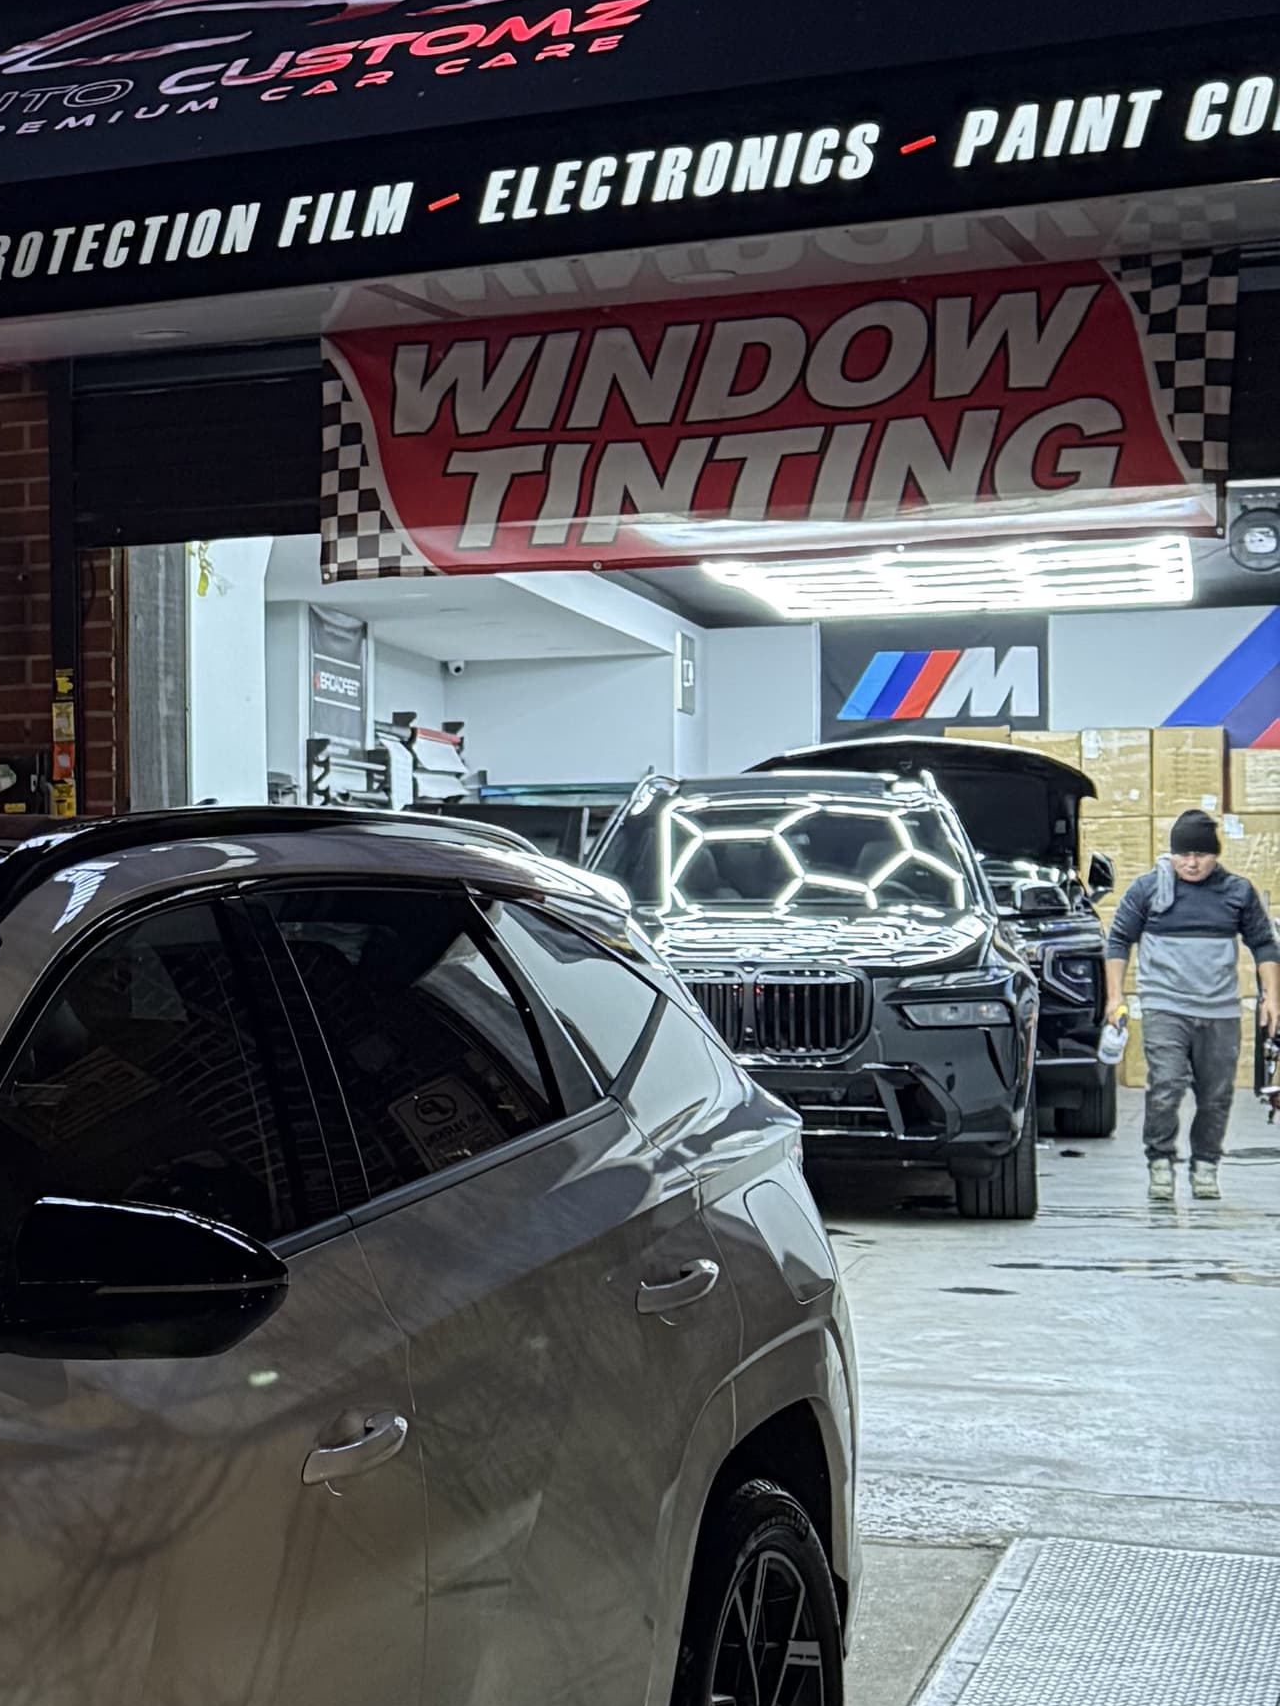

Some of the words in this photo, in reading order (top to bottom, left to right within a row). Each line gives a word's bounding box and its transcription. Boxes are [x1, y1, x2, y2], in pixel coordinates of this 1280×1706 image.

[260, 70, 395, 102] CAR
[435, 34, 624, 75] CARE
[277, 181, 415, 249] FILM
[477, 123, 881, 225] ELECTRONICS
[953, 89, 1163, 168] PAINT
[1184, 75, 1280, 142] CO
[391, 284, 1102, 436] WINDOW
[445, 397, 1124, 550] TINTING
